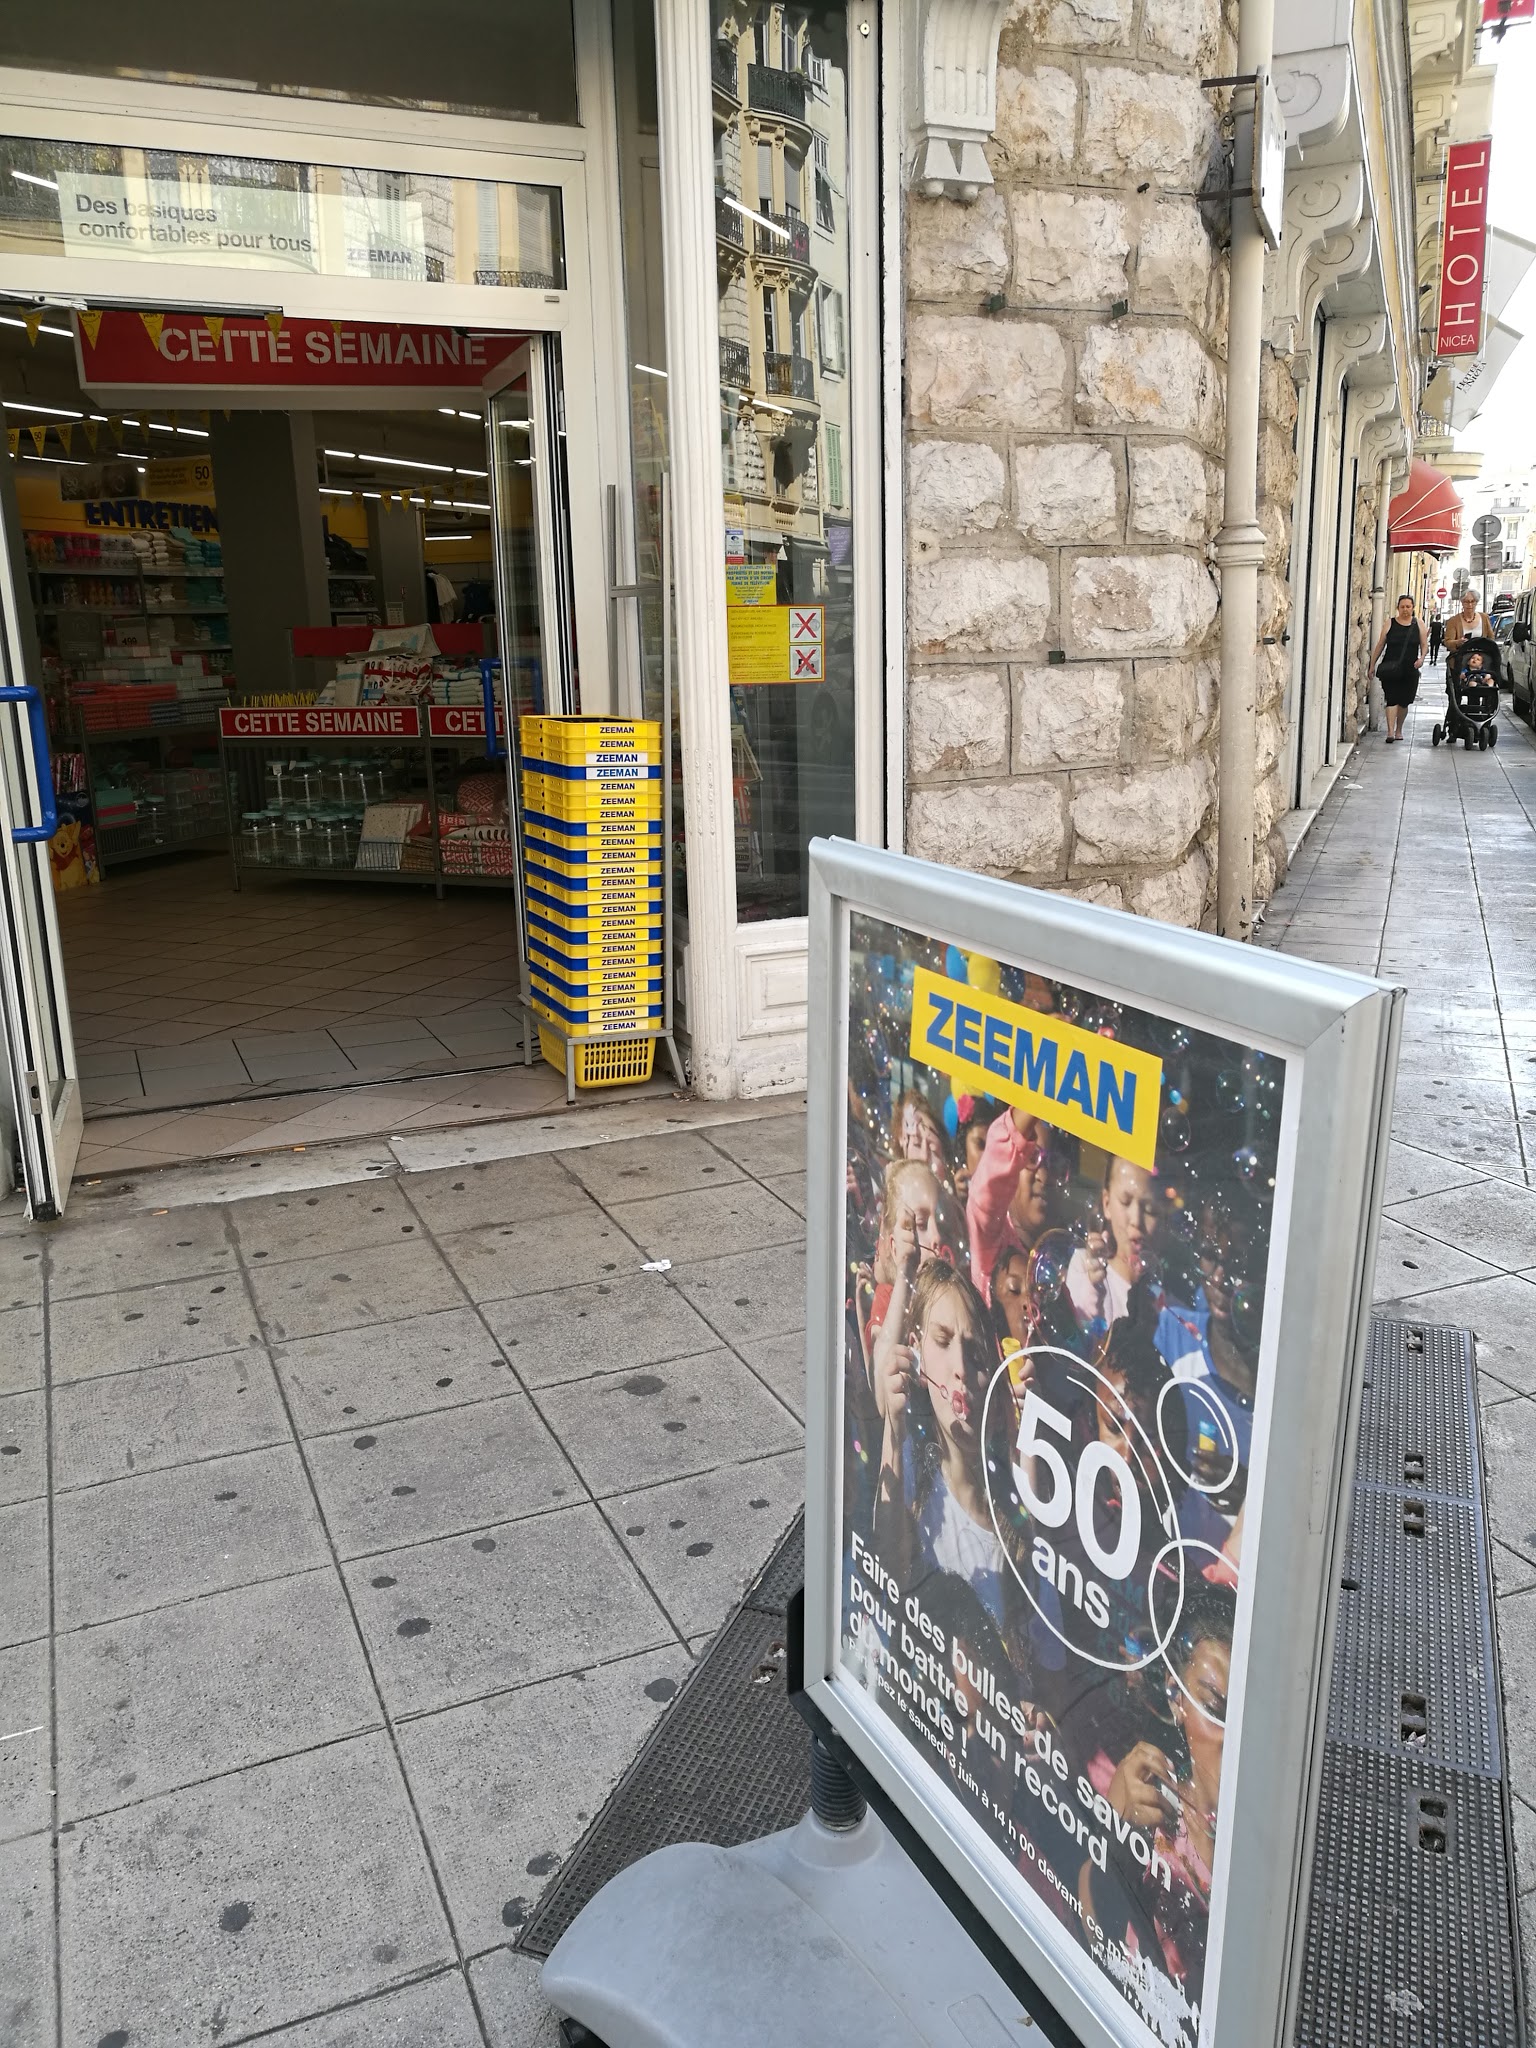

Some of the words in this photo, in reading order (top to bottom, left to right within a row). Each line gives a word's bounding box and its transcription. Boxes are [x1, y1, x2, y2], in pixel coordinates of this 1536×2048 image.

[76, 194, 118, 215] Des
[123, 198, 218, 224] basiques
[79, 221, 211, 245] confortables
[217, 231, 263, 250] pour
[268, 233, 317, 252] tous.
[1444, 151, 1485, 326] HOTEL
[346, 248, 412, 264] ZEEMAN
[1440, 334, 1475, 348] NICEA
[158, 328, 294, 363] CETTE
[305, 331, 488, 366] SEMAINE
[195, 466, 210, 480] 50
[85, 500, 219, 532] ENTRETIEN
[234, 712, 300, 734] CETTE
[305, 711, 404, 733] SEMAINE
[445, 710, 503, 732] CETT
[600, 726, 634, 734] ZEEMAN
[600, 740, 634, 748] ZEEMAN
[596, 753, 638, 763] ZEEMAN
[596, 768, 638, 778] ZEEMAN
[600, 782, 635, 791] ZEEMAN
[601, 797, 635, 806] ZEEMAN
[600, 810, 634, 819] ZEEMAN
[600, 824, 635, 833] ZEEMAN
[600, 837, 635, 847] ZEEMAN
[601, 851, 635, 860] ZEEMAN
[600, 866, 635, 875] ZEEMAN
[601, 877, 635, 887] ZEEMAN
[601, 891, 635, 900] ZEEMAN
[601, 904, 635, 914] ZEEMAN
[601, 918, 635, 928] ZEEMAN
[602, 931, 636, 941] ZEEMAN
[601, 944, 635, 953] ZEEMAN
[601, 957, 635, 967] ZEEMAN
[602, 971, 635, 980] ZEEMAN
[601, 984, 635, 993] ZEEMAN
[601, 997, 636, 1006] ZEEMAN
[602, 1010, 635, 1019] ZEEMAN
[602, 1023, 636, 1032] ZEEMAN
[926, 992, 1137, 1135] ZEEMAN
[1012, 1388, 1142, 1581] 50
[1032, 1536, 1110, 1629] ans
[880, 1646, 955, 1741] monde
[851, 1531, 900, 1604] Faire
[905, 1596, 946, 1654] des
[952, 1636, 1026, 1737] bulles
[1035, 1730, 1069, 1782] de
[1077, 1775, 1172, 1893] savon
[850, 1574, 897, 1638] pour
[901, 1622, 969, 1717] battre
[976, 1709, 1007, 1762] un
[1014, 1751, 1108, 1873] record
[897, 1692, 908, 1712] le
[908, 1710, 947, 1760] samedi
[949, 1753, 957, 1769] 3
[957, 1762, 979, 1797] juin
[981, 1790, 989, 1809] à
[993, 1803, 1006, 1827] 14
[1008, 1819, 1017, 1841] h
[1019, 1834, 1035, 1862] 00
[1037, 1857, 1084, 1918] devant
[1086, 1914, 1104, 1941] ce
